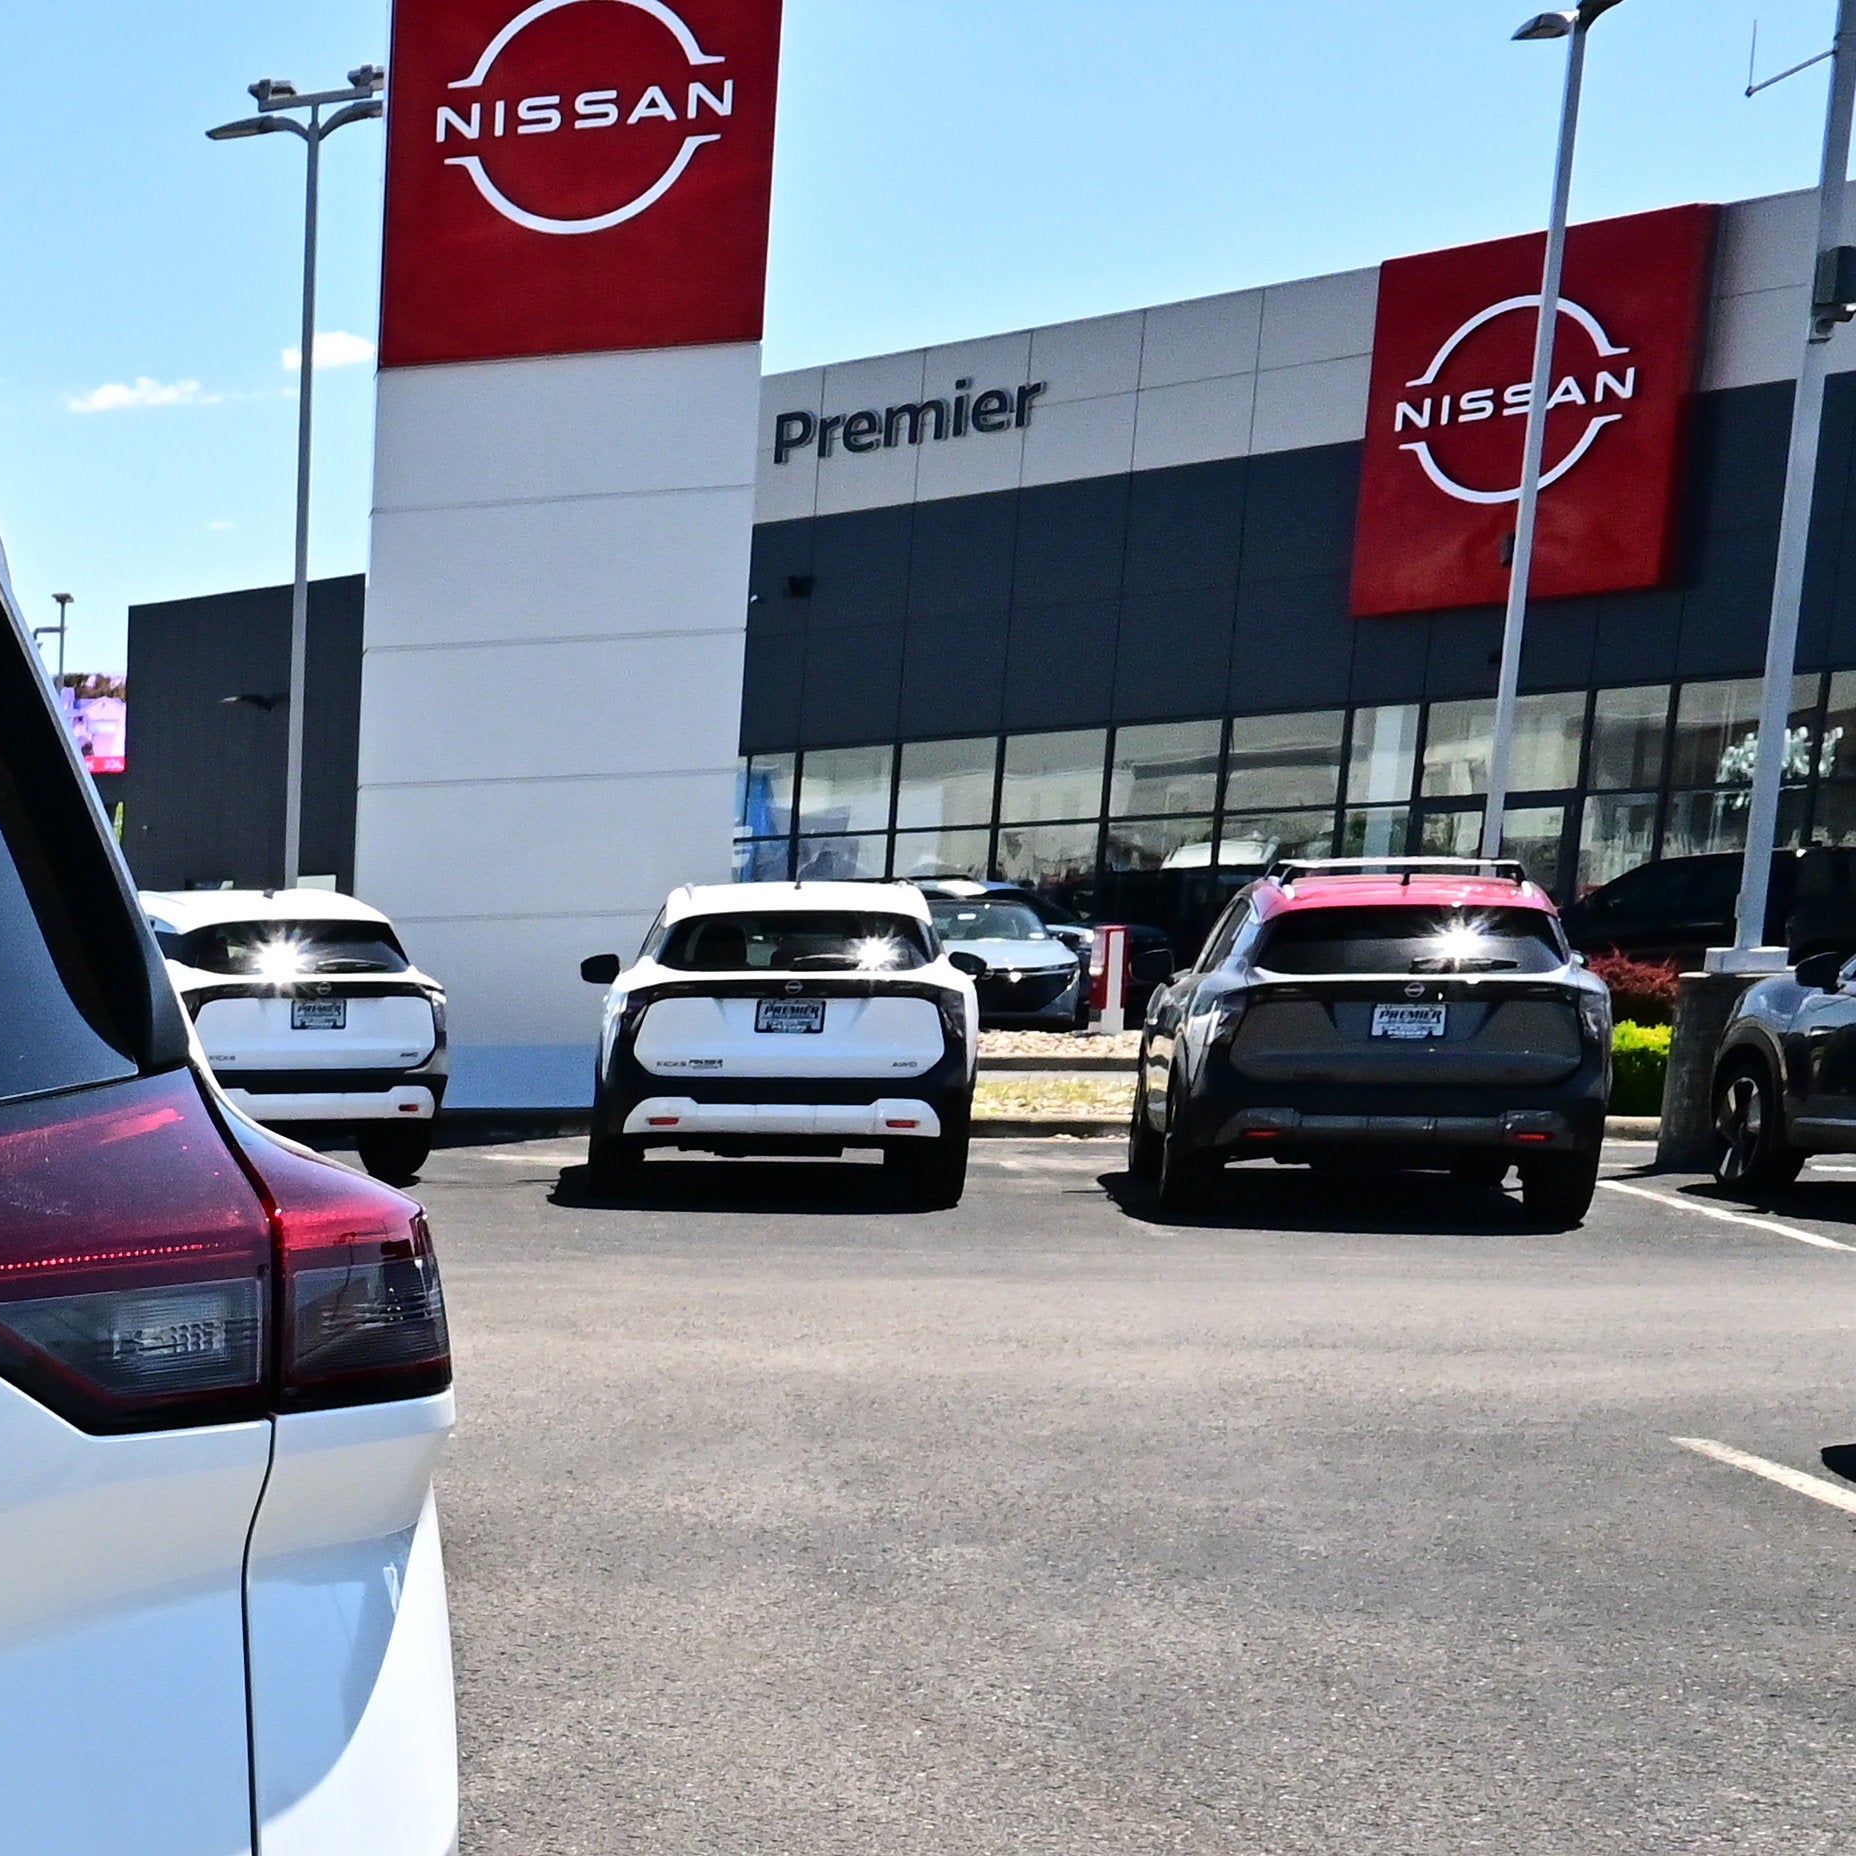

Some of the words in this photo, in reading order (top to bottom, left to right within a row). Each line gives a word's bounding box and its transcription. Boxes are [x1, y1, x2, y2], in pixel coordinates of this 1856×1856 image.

[436, 78, 734, 144] NISSAN
[774, 377, 1045, 465] Premier
[1394, 367, 1636, 432] NISSAN
